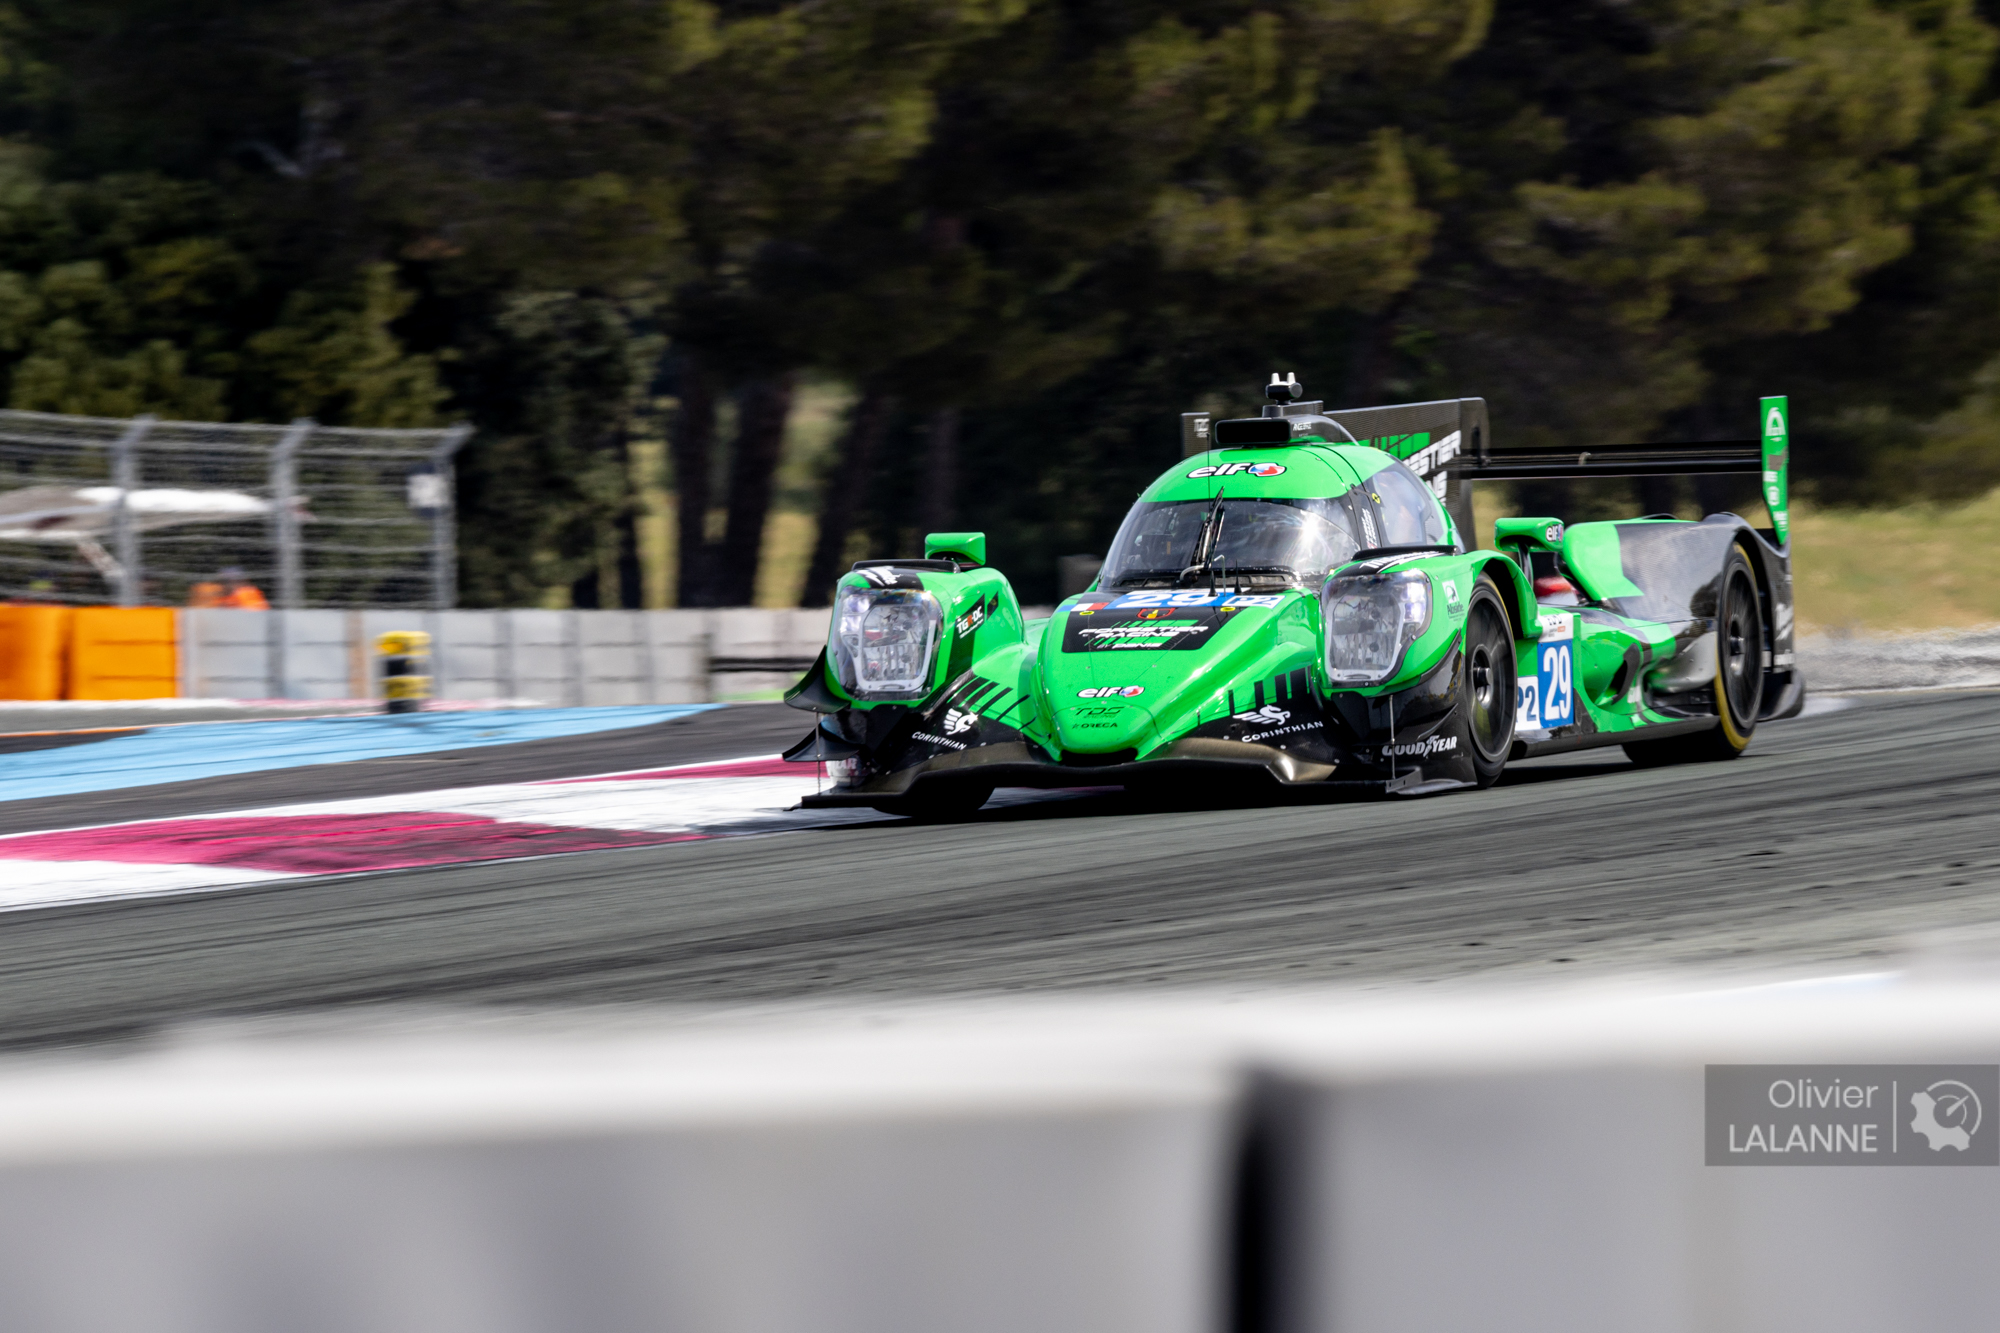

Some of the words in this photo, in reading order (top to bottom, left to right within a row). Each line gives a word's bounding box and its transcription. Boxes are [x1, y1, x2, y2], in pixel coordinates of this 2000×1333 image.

[1116, 592, 1218, 608] 29
[1229, 596, 1278, 605] P2
[1078, 625, 1209, 635] FORESTIER
[1095, 631, 1180, 639] RACING
[1543, 645, 1571, 721] 29
[1076, 706, 1126, 716] TDS
[1241, 720, 1324, 743] CORINTHIAN
[911, 731, 968, 751] CORINTHIAN
